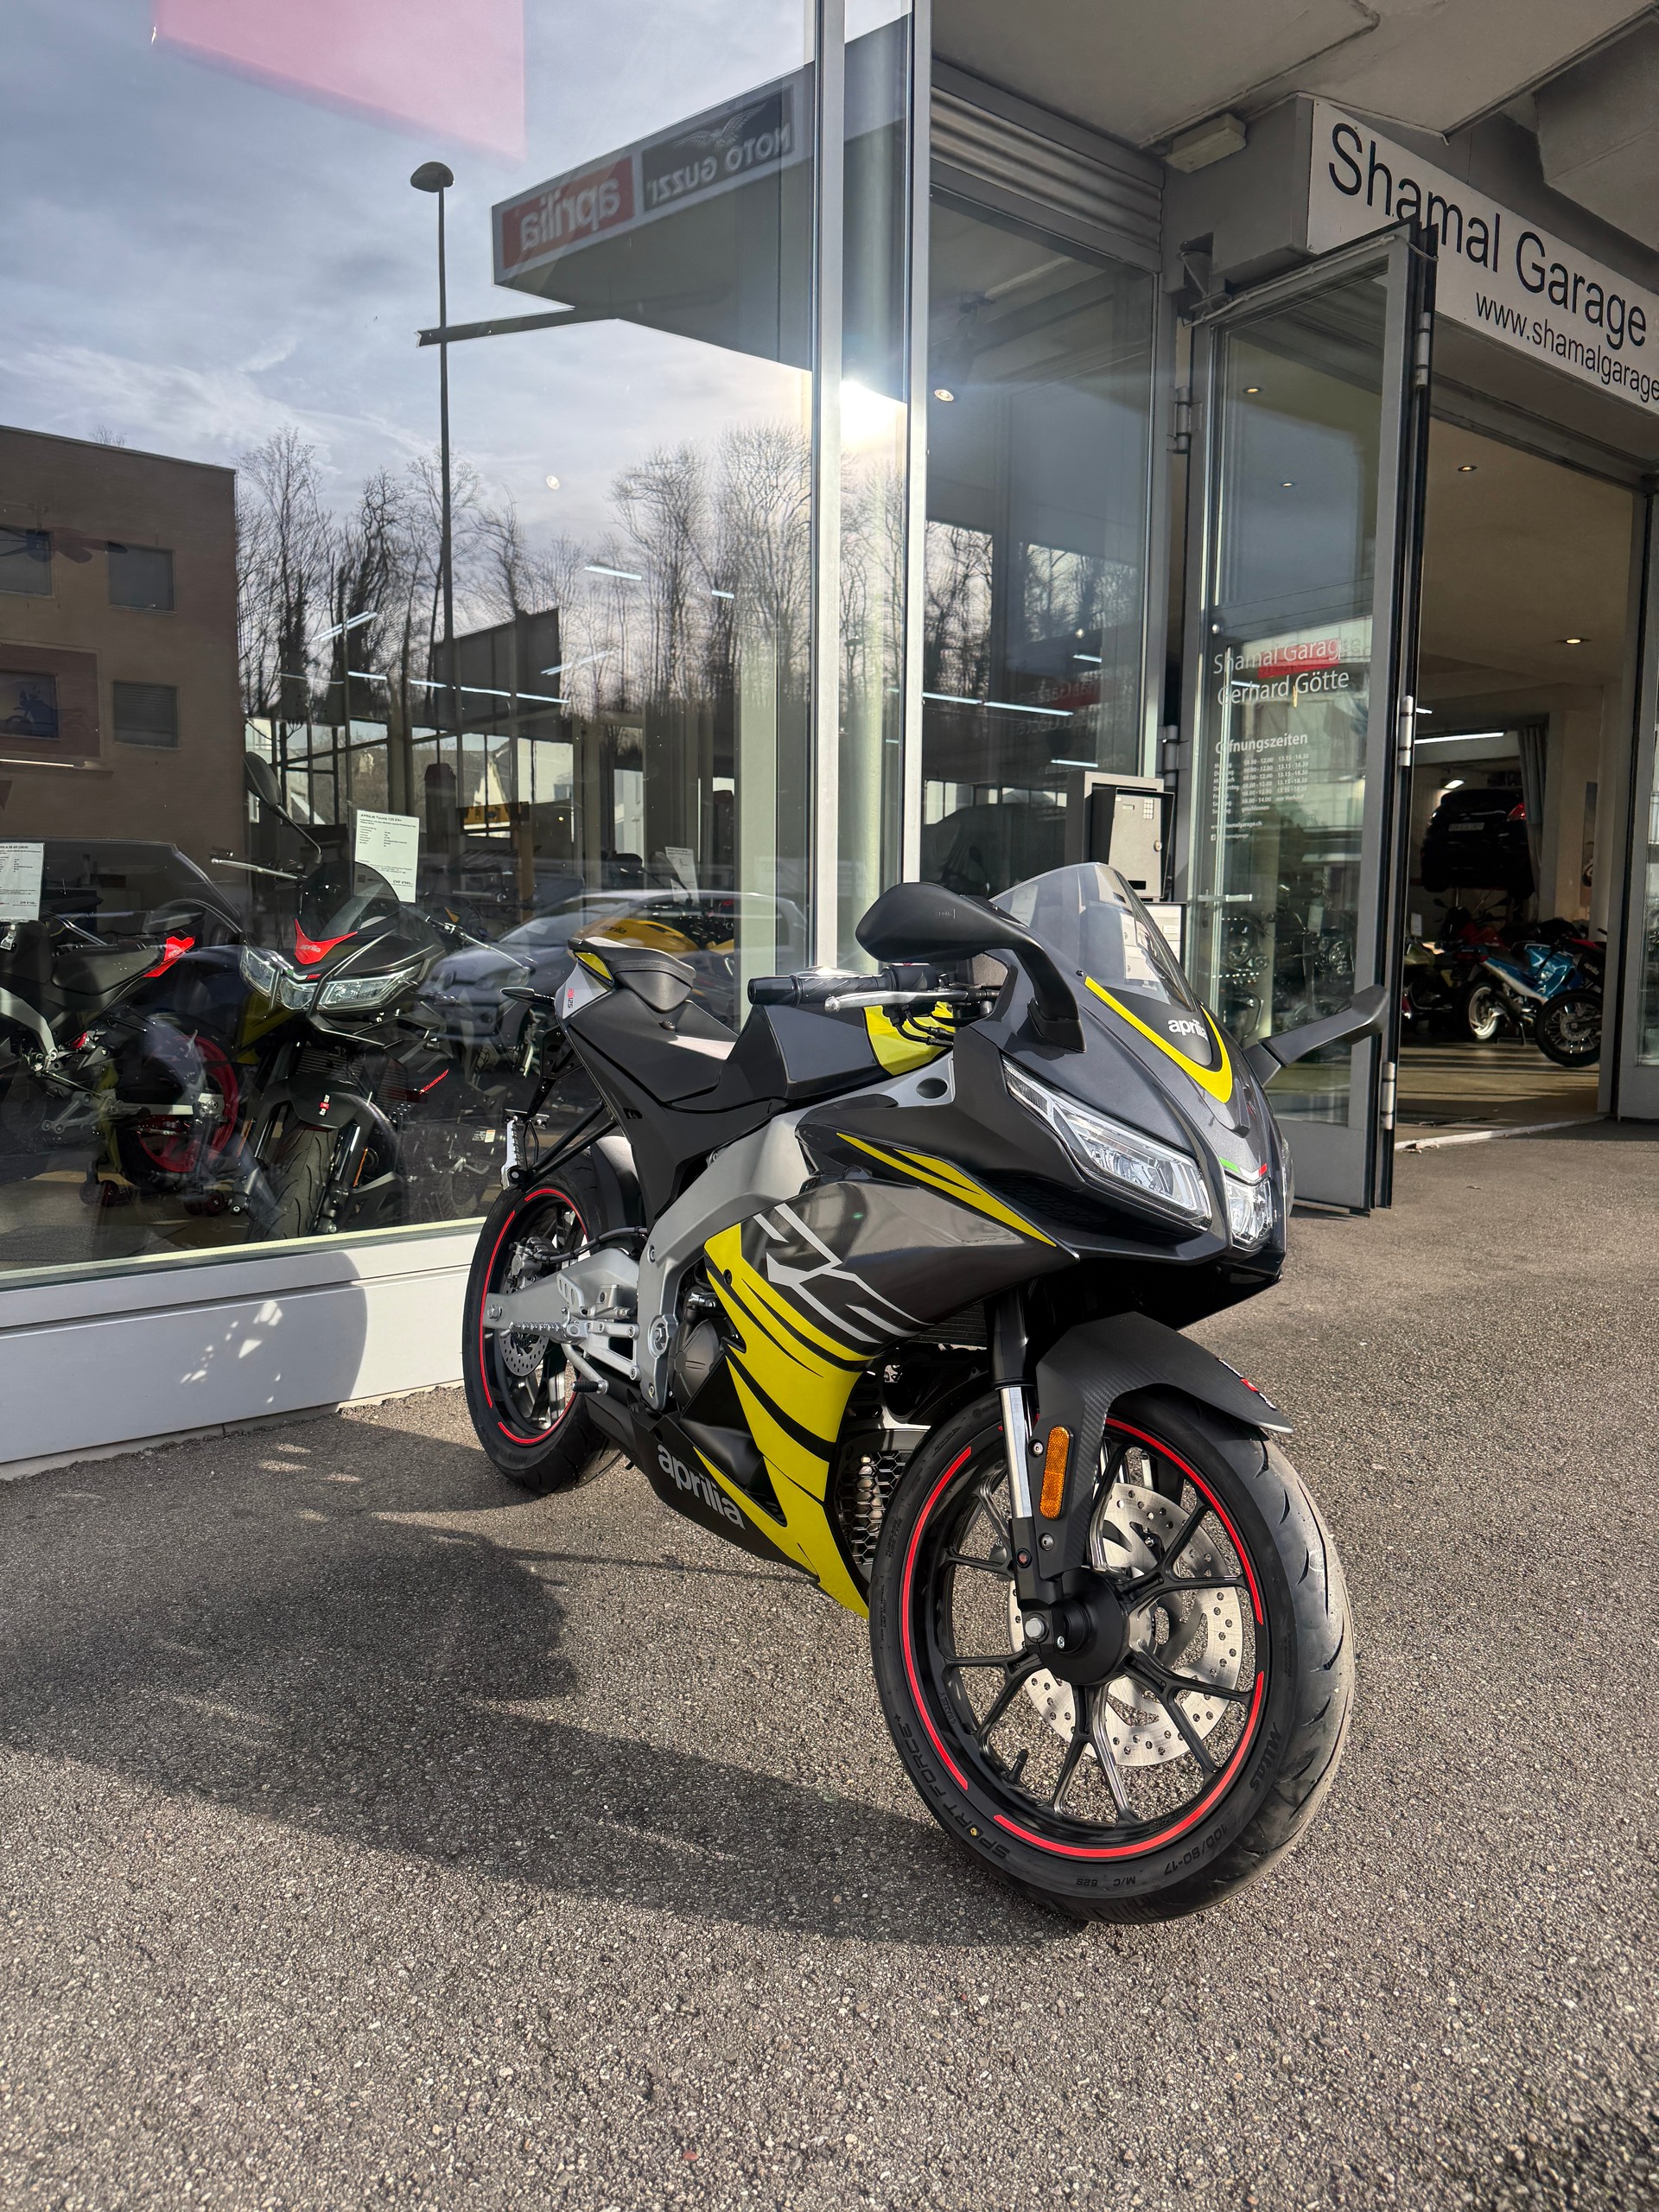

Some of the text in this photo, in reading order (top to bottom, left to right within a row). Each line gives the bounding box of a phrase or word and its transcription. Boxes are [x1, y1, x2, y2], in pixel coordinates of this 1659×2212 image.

[1329, 123, 1647, 350] Shamal Garage
[1476, 292, 1659, 403] www.shamalgarage
[1213, 639, 1341, 675] Shamal Garag
[1217, 671, 1350, 707] Gerhard Götte
[1215, 734, 1307, 754] fnungszeiten
[300, 944, 321, 953] aprilia
[1168, 1019, 1209, 1042] aprilia
[657, 1444, 746, 1530] aprilia
[893, 1713, 1011, 1859] SPORT FORCE+
[1076, 1824, 1227, 1887] 100/80-17 M/C 52S
